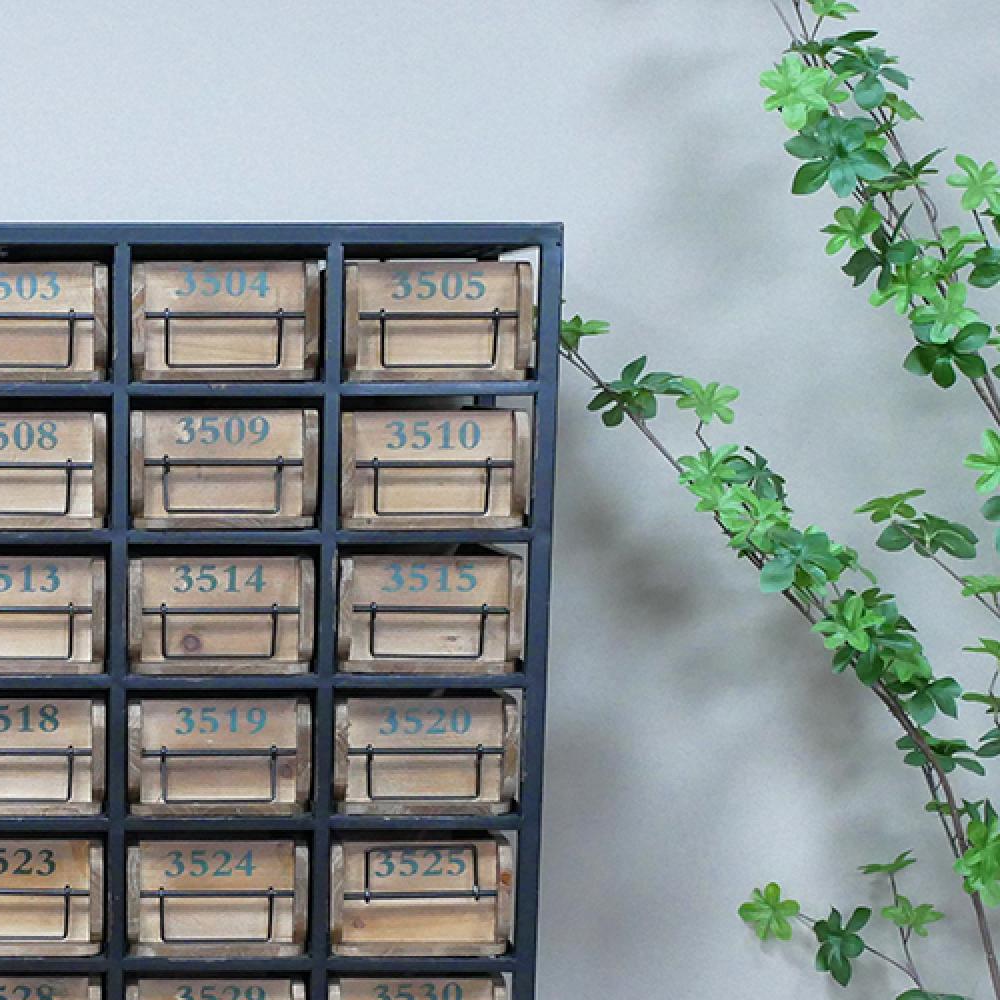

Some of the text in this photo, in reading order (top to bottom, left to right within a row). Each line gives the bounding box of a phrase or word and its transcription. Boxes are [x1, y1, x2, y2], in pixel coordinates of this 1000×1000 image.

[175, 265, 271, 298] 3504
[391, 270, 486, 300] 3505
[175, 415, 270, 445] 3509
[386, 419, 481, 449] 3510
[173, 563, 265, 593] 3514
[382, 563, 477, 593] 3515
[176, 706, 268, 735] 3519
[379, 707, 472, 736] 3520
[165, 848, 256, 877] 3524
[374, 848, 466, 877] 3525
